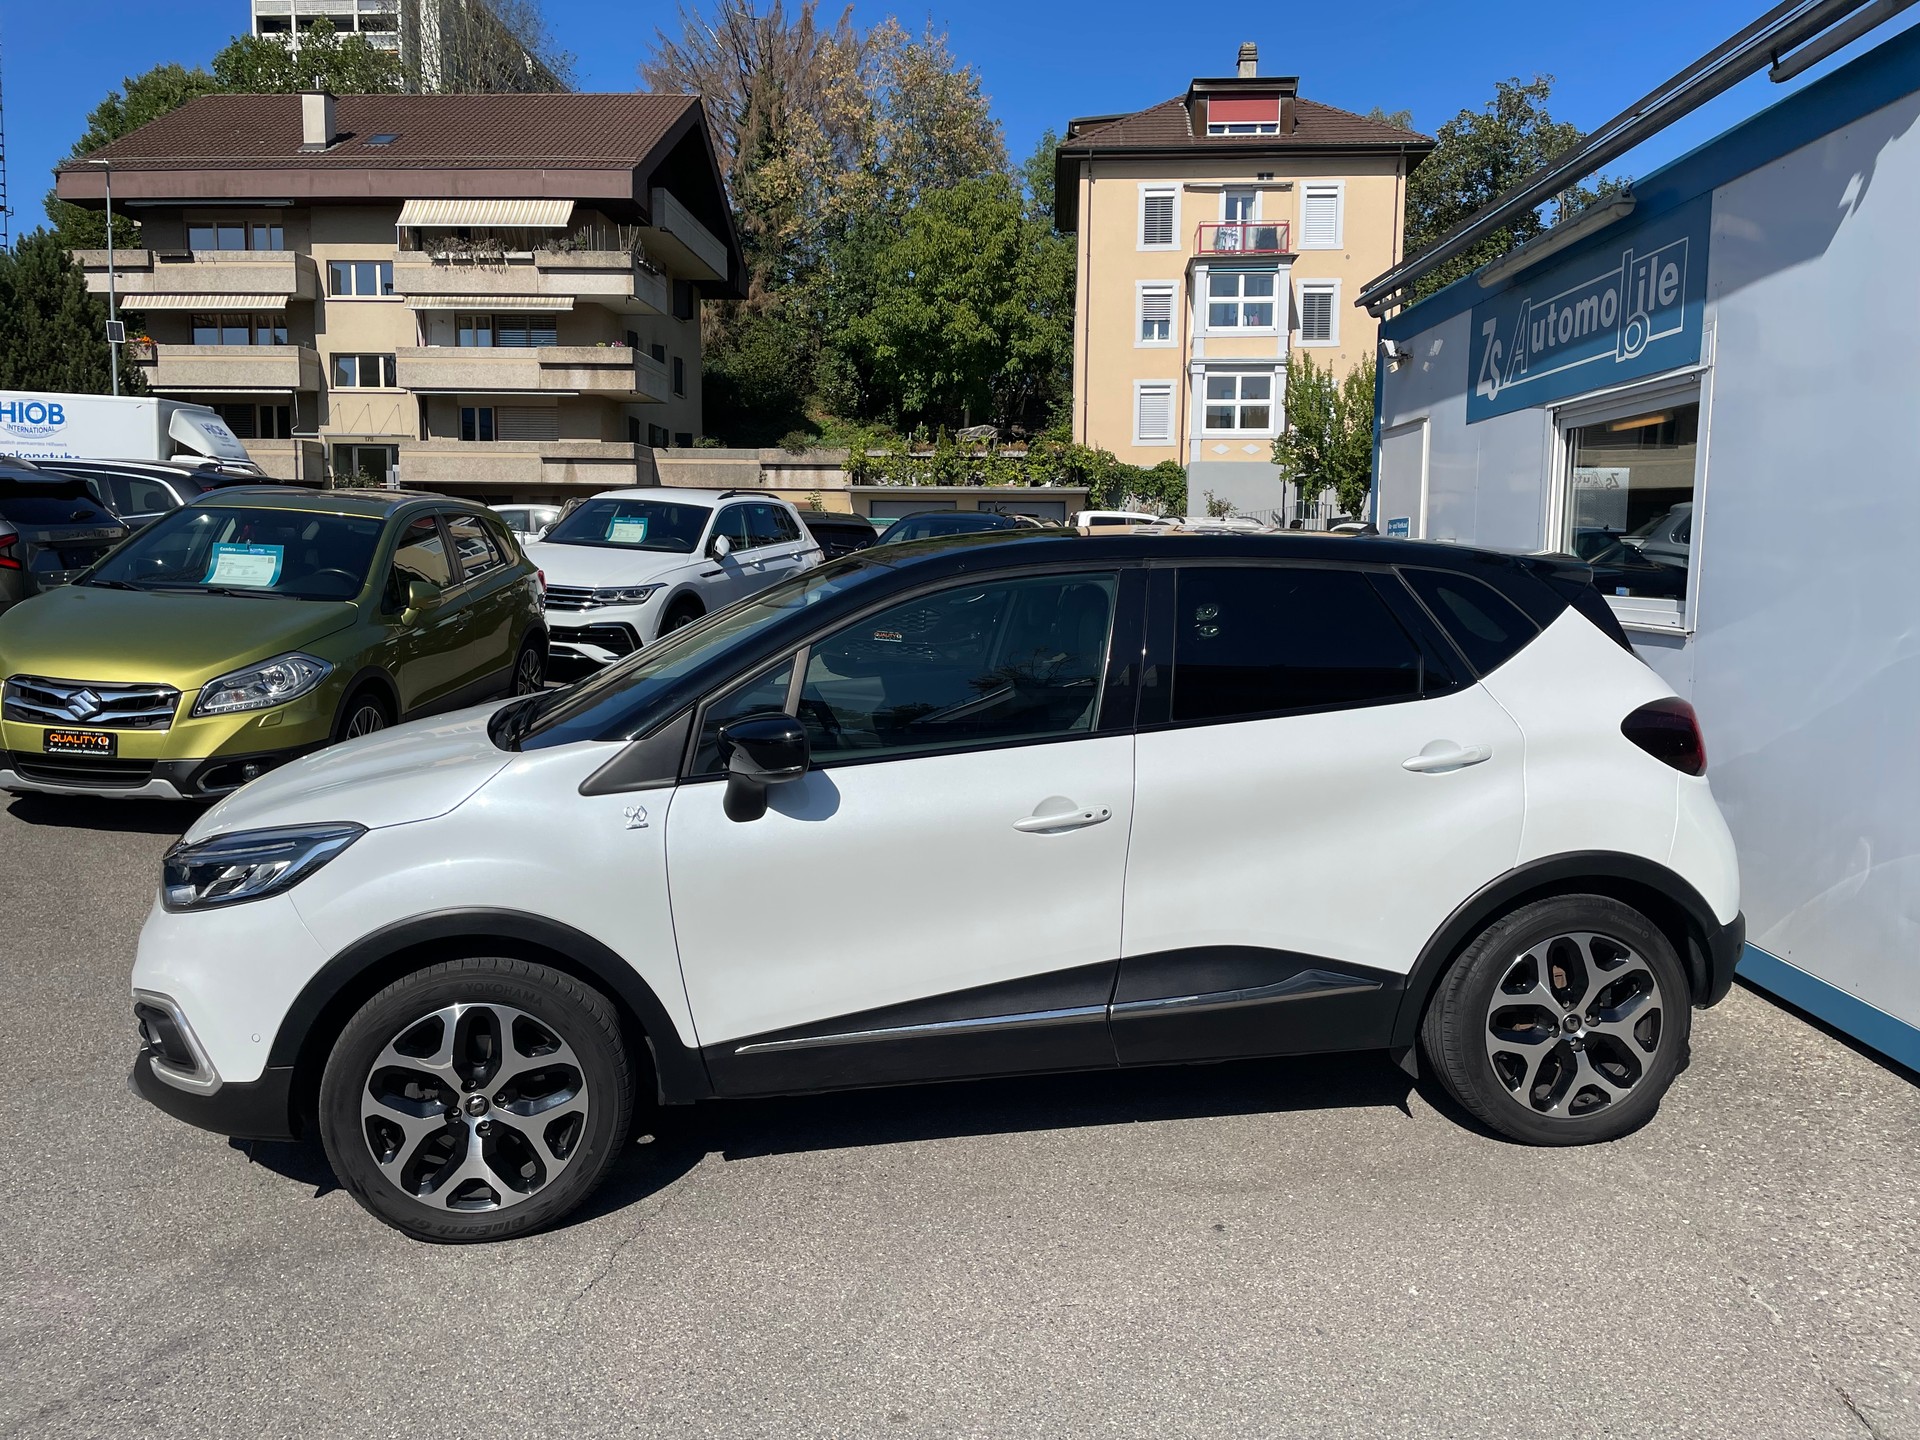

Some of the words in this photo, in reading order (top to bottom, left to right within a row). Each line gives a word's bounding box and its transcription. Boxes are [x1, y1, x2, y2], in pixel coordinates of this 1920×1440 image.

[0, 402, 65, 425] HIOB
[6, 423, 56, 434] INTERNATIONAL
[49, 734, 98, 743] QUALITY
[465, 982, 543, 1007] YOKOHAMA
